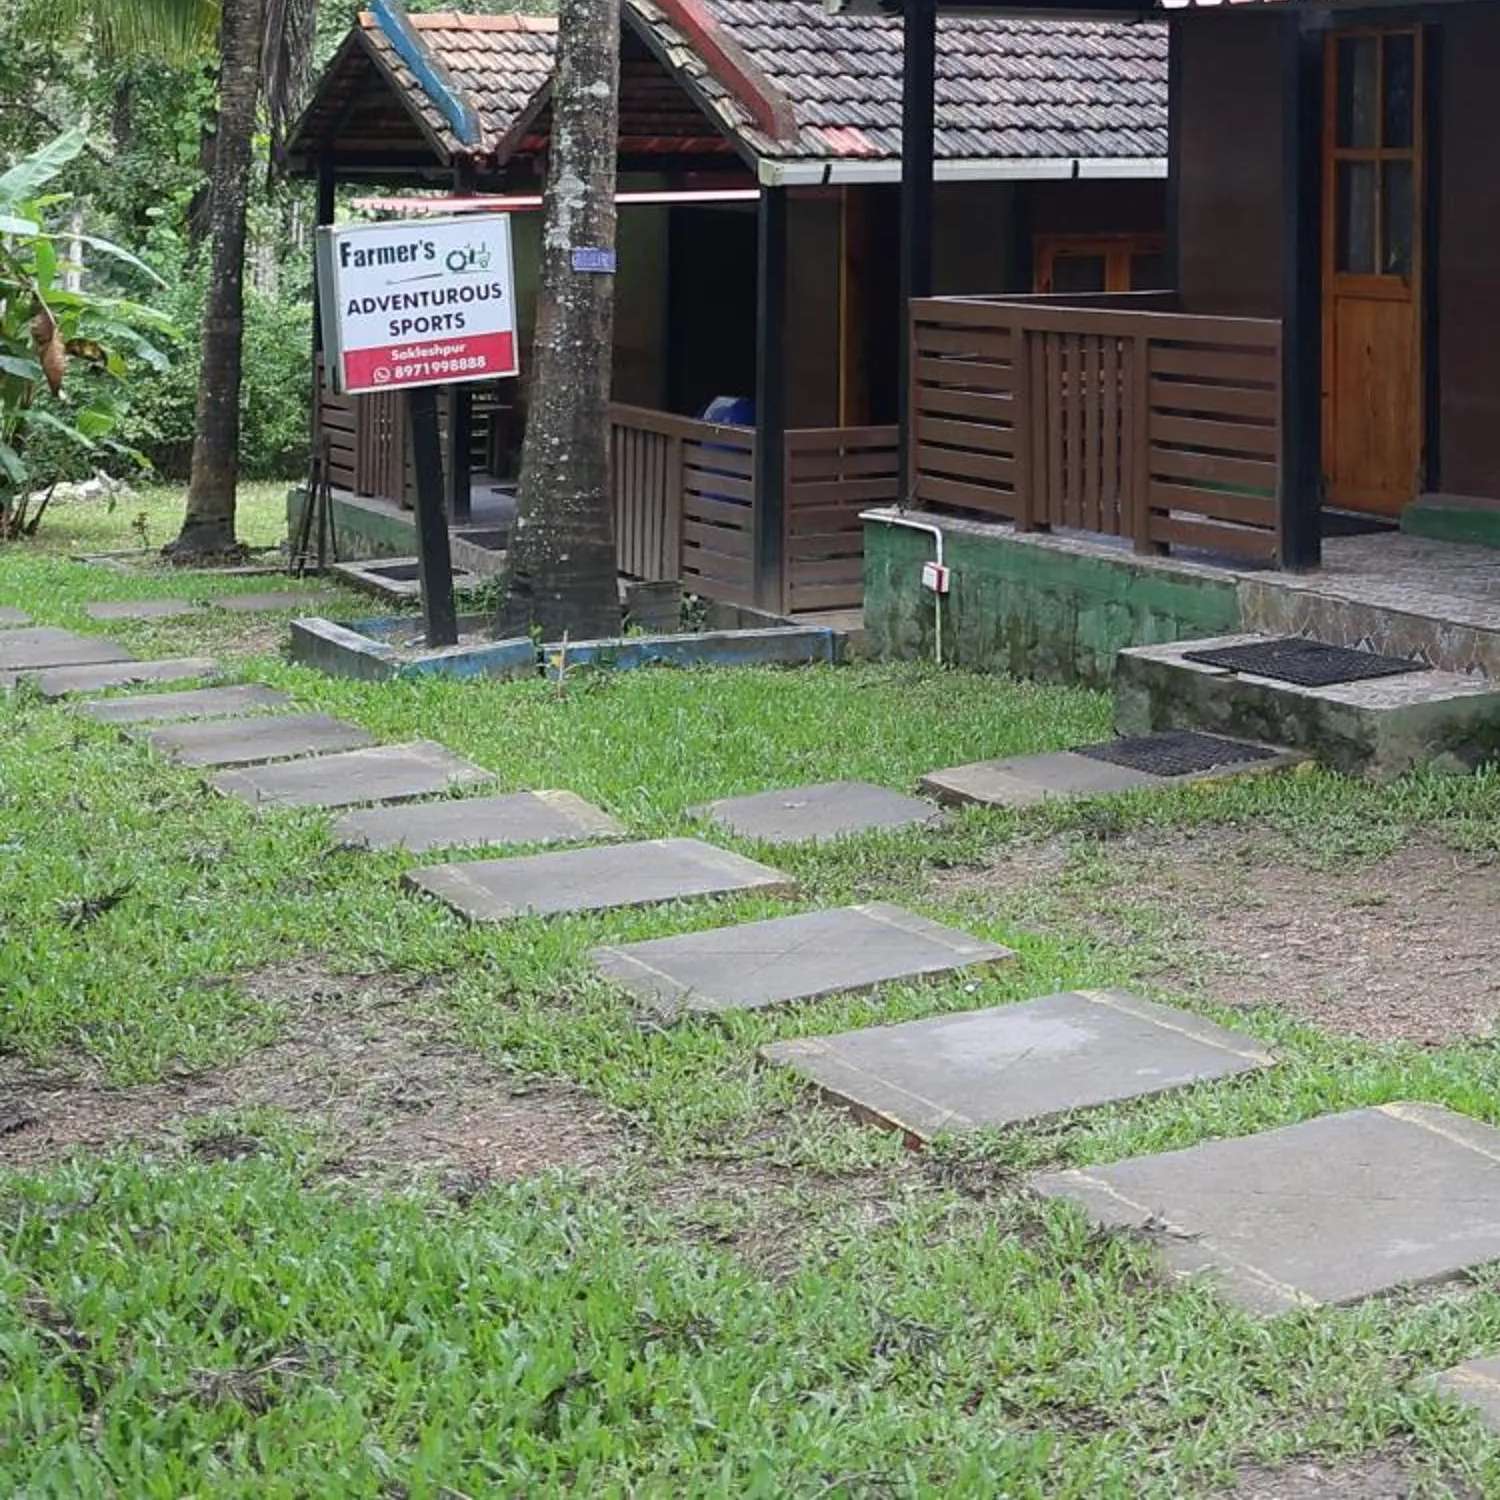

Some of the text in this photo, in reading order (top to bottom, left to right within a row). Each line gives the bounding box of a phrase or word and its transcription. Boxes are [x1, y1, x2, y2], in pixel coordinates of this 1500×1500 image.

[339, 239, 436, 268] Farmer's
[347, 282, 503, 316] ADVENTUROUS
[389, 312, 466, 337] SPORTS
[391, 343, 467, 361] Sakleshpur
[394, 355, 487, 379] 8971998888
